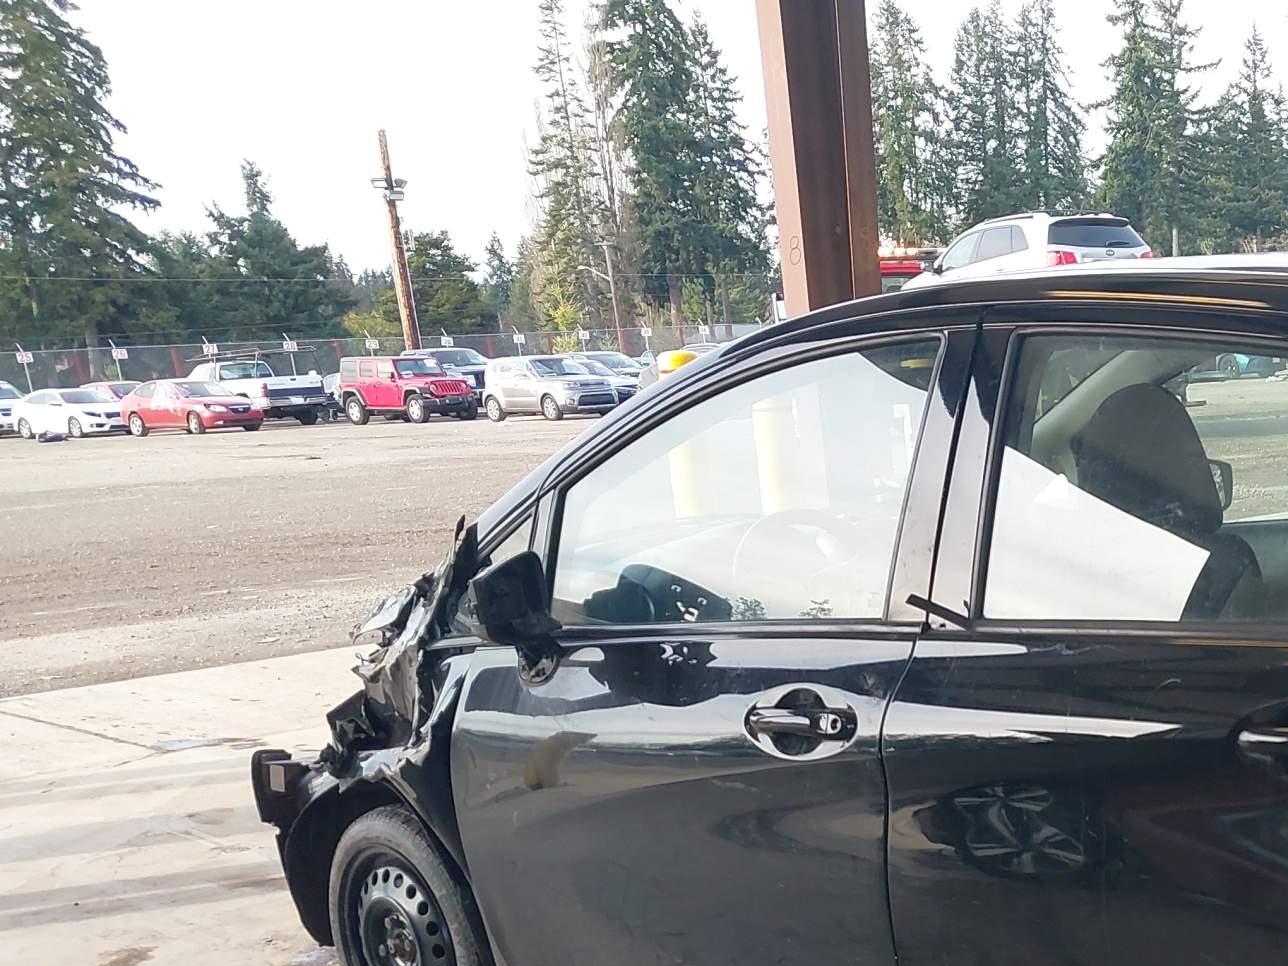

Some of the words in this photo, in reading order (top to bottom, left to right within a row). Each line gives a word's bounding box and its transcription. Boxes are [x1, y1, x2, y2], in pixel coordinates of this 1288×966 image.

[789, 235, 802, 266] 8
[205, 344, 217, 353] 27
[18, 351, 32, 362] 25
